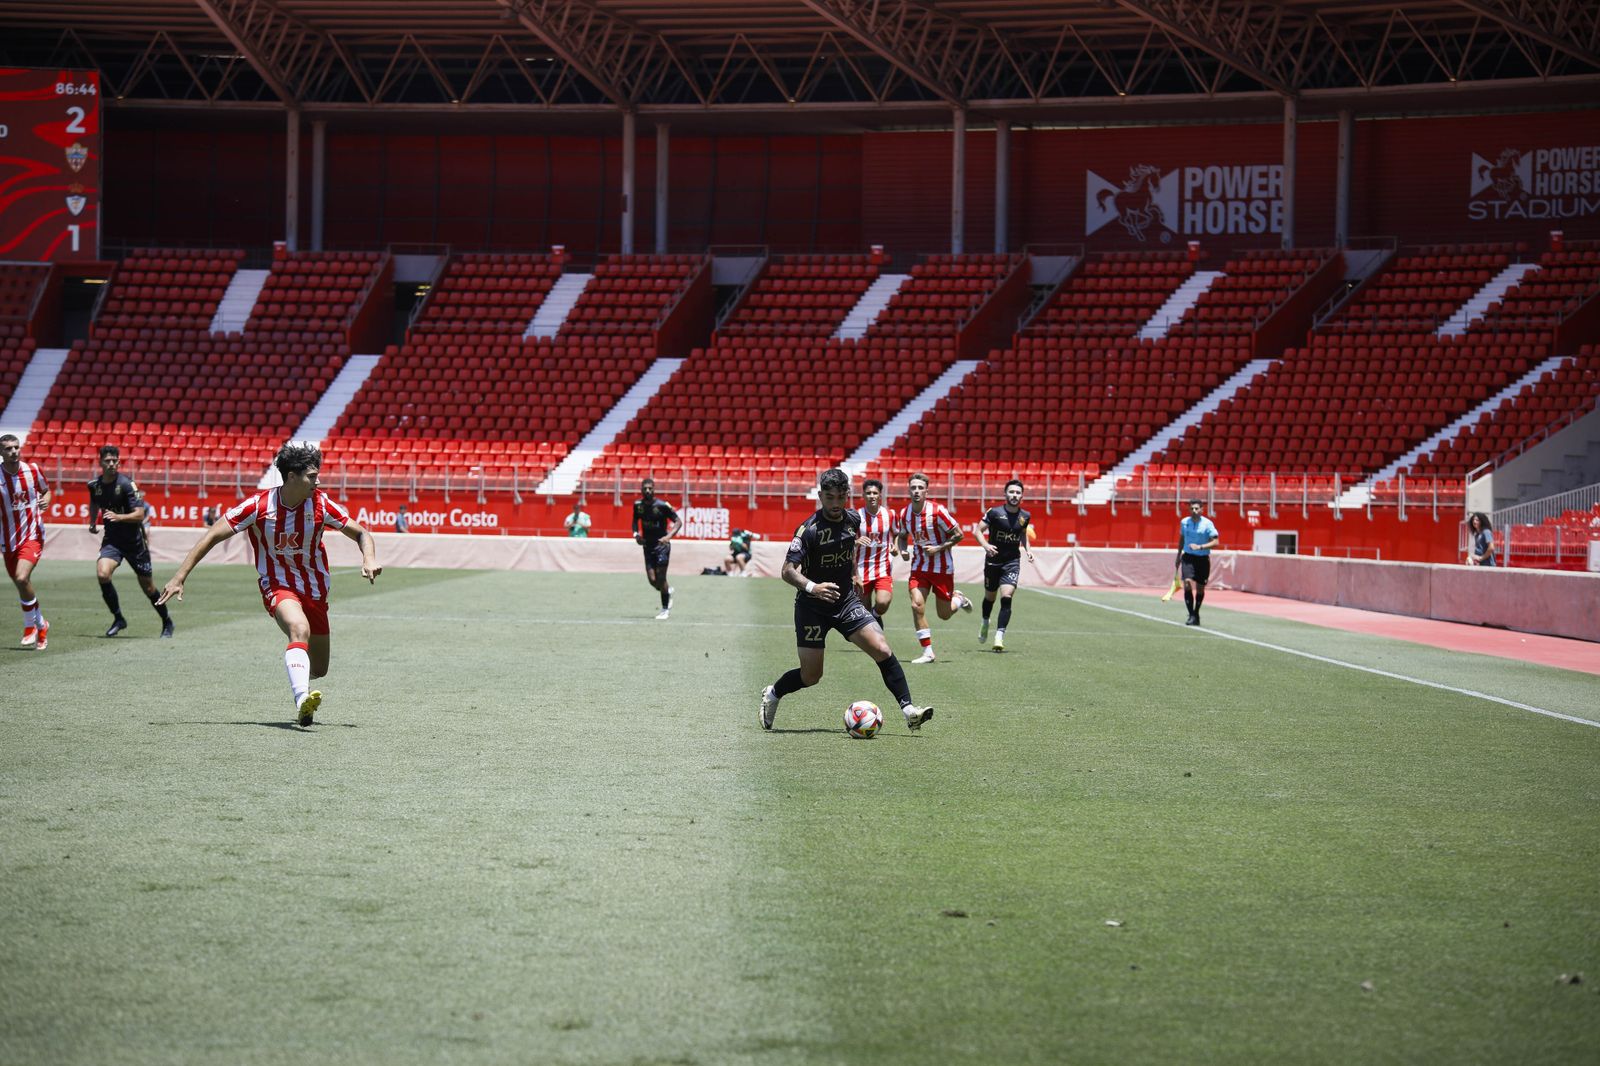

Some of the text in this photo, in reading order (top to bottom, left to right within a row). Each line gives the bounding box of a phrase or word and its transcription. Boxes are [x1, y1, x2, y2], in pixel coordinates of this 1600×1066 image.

[56, 82, 97, 96] 86:44
[65, 106, 86, 134] 2
[1536, 145, 1600, 172] POWER
[1184, 165, 1284, 200] POWER
[1536, 170, 1600, 196] HORSE
[1184, 200, 1284, 235] HORSE
[1468, 197, 1600, 221] STADIUM
[67, 224, 80, 252] 1
[148, 503, 232, 520] ALMEÍ
[449, 508, 498, 527] Costa
[686, 507, 730, 523] POWER
[686, 522, 730, 539] HORSE
[817, 527, 835, 546] 22
[804, 625, 823, 642] 22
